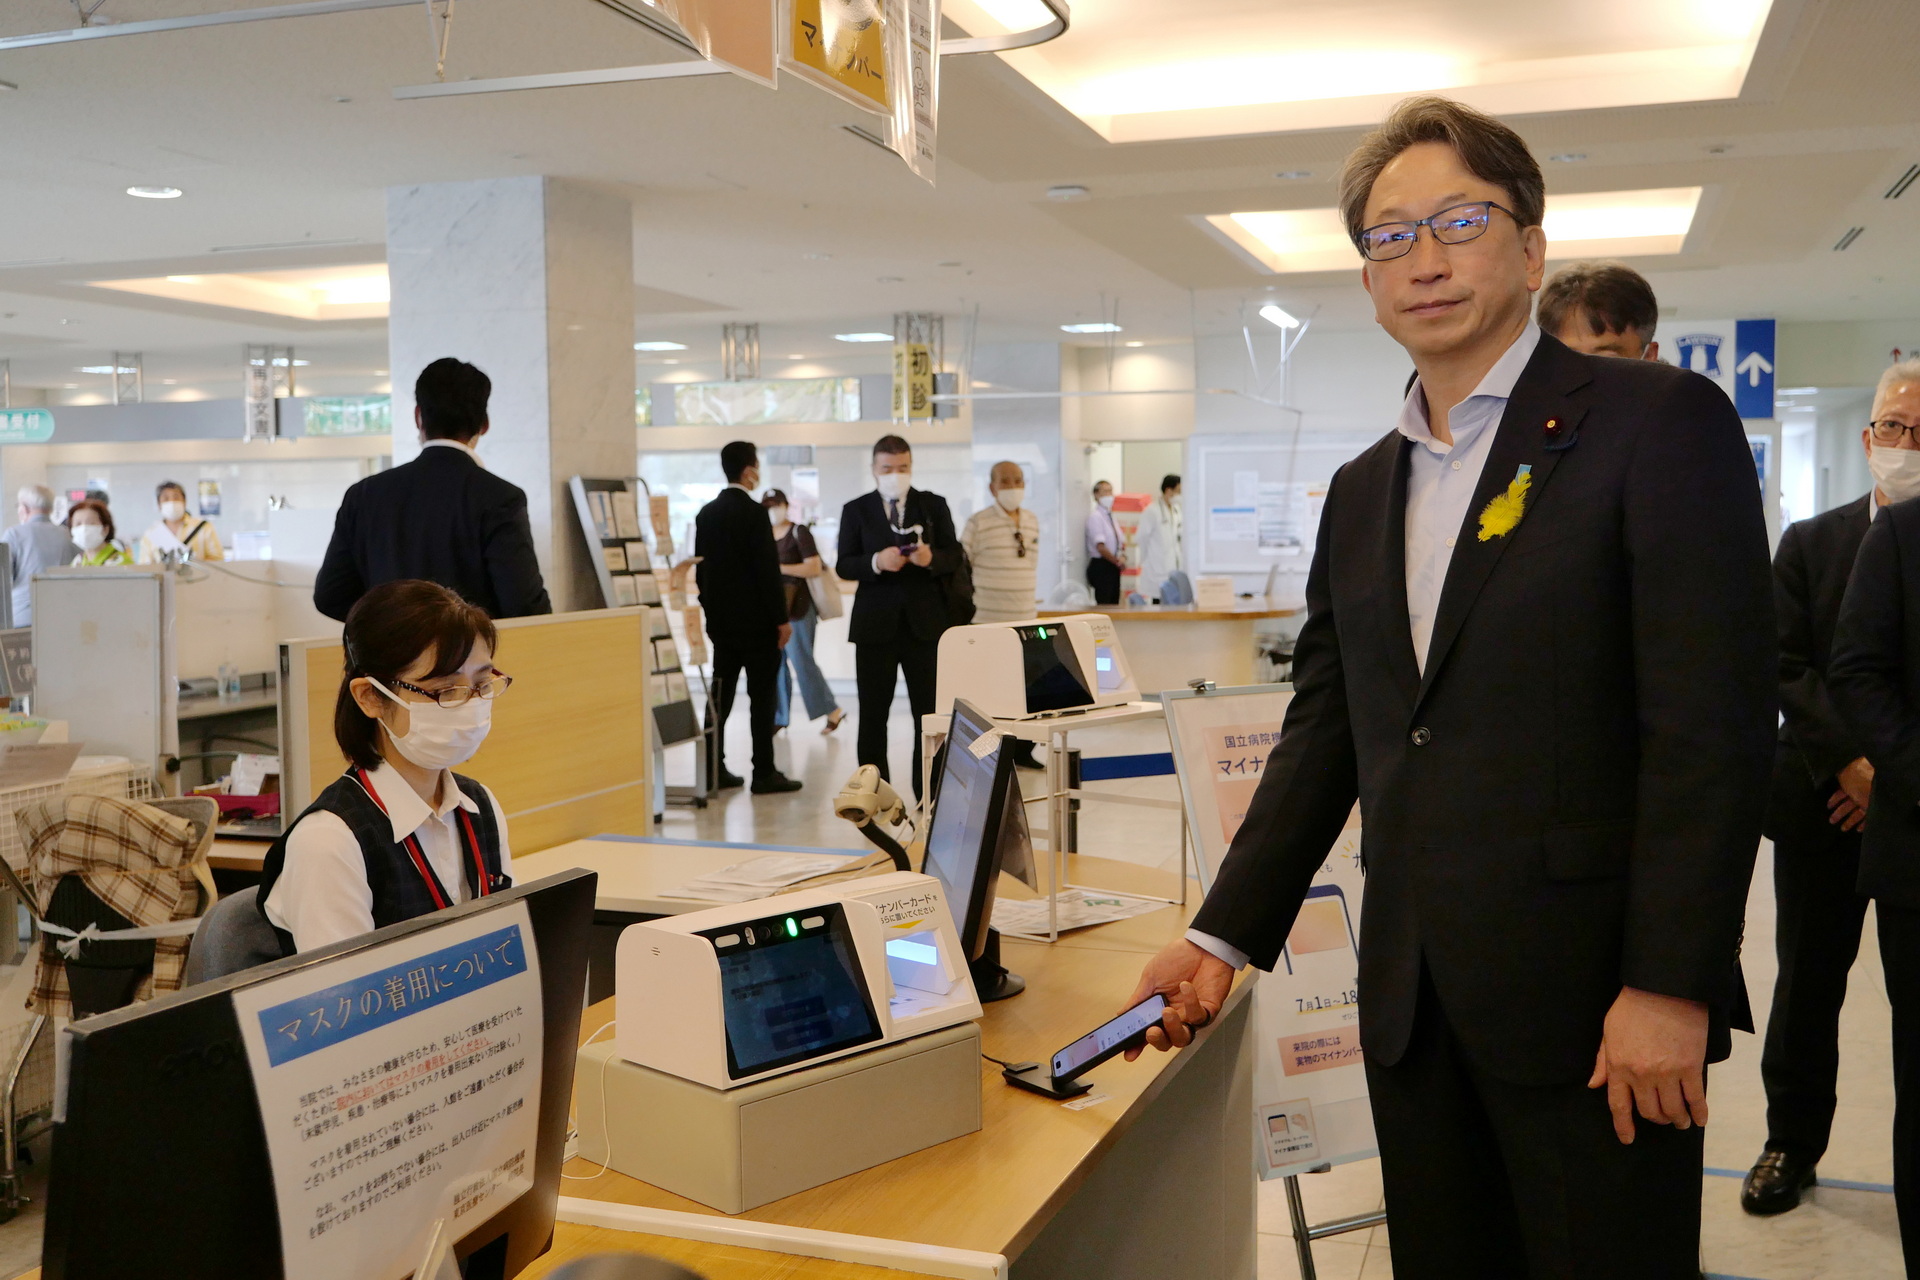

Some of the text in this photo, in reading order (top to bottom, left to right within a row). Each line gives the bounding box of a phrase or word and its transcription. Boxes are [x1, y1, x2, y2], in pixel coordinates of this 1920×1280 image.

[911, 347, 928, 411] 初診
[1217, 756, 1264, 775] マイナ
[278, 939, 513, 1041] マスクの着用について
[1292, 1036, 1342, 1053] 来院の際には
[1295, 1046, 1363, 1067] 実物のマイナンバー
